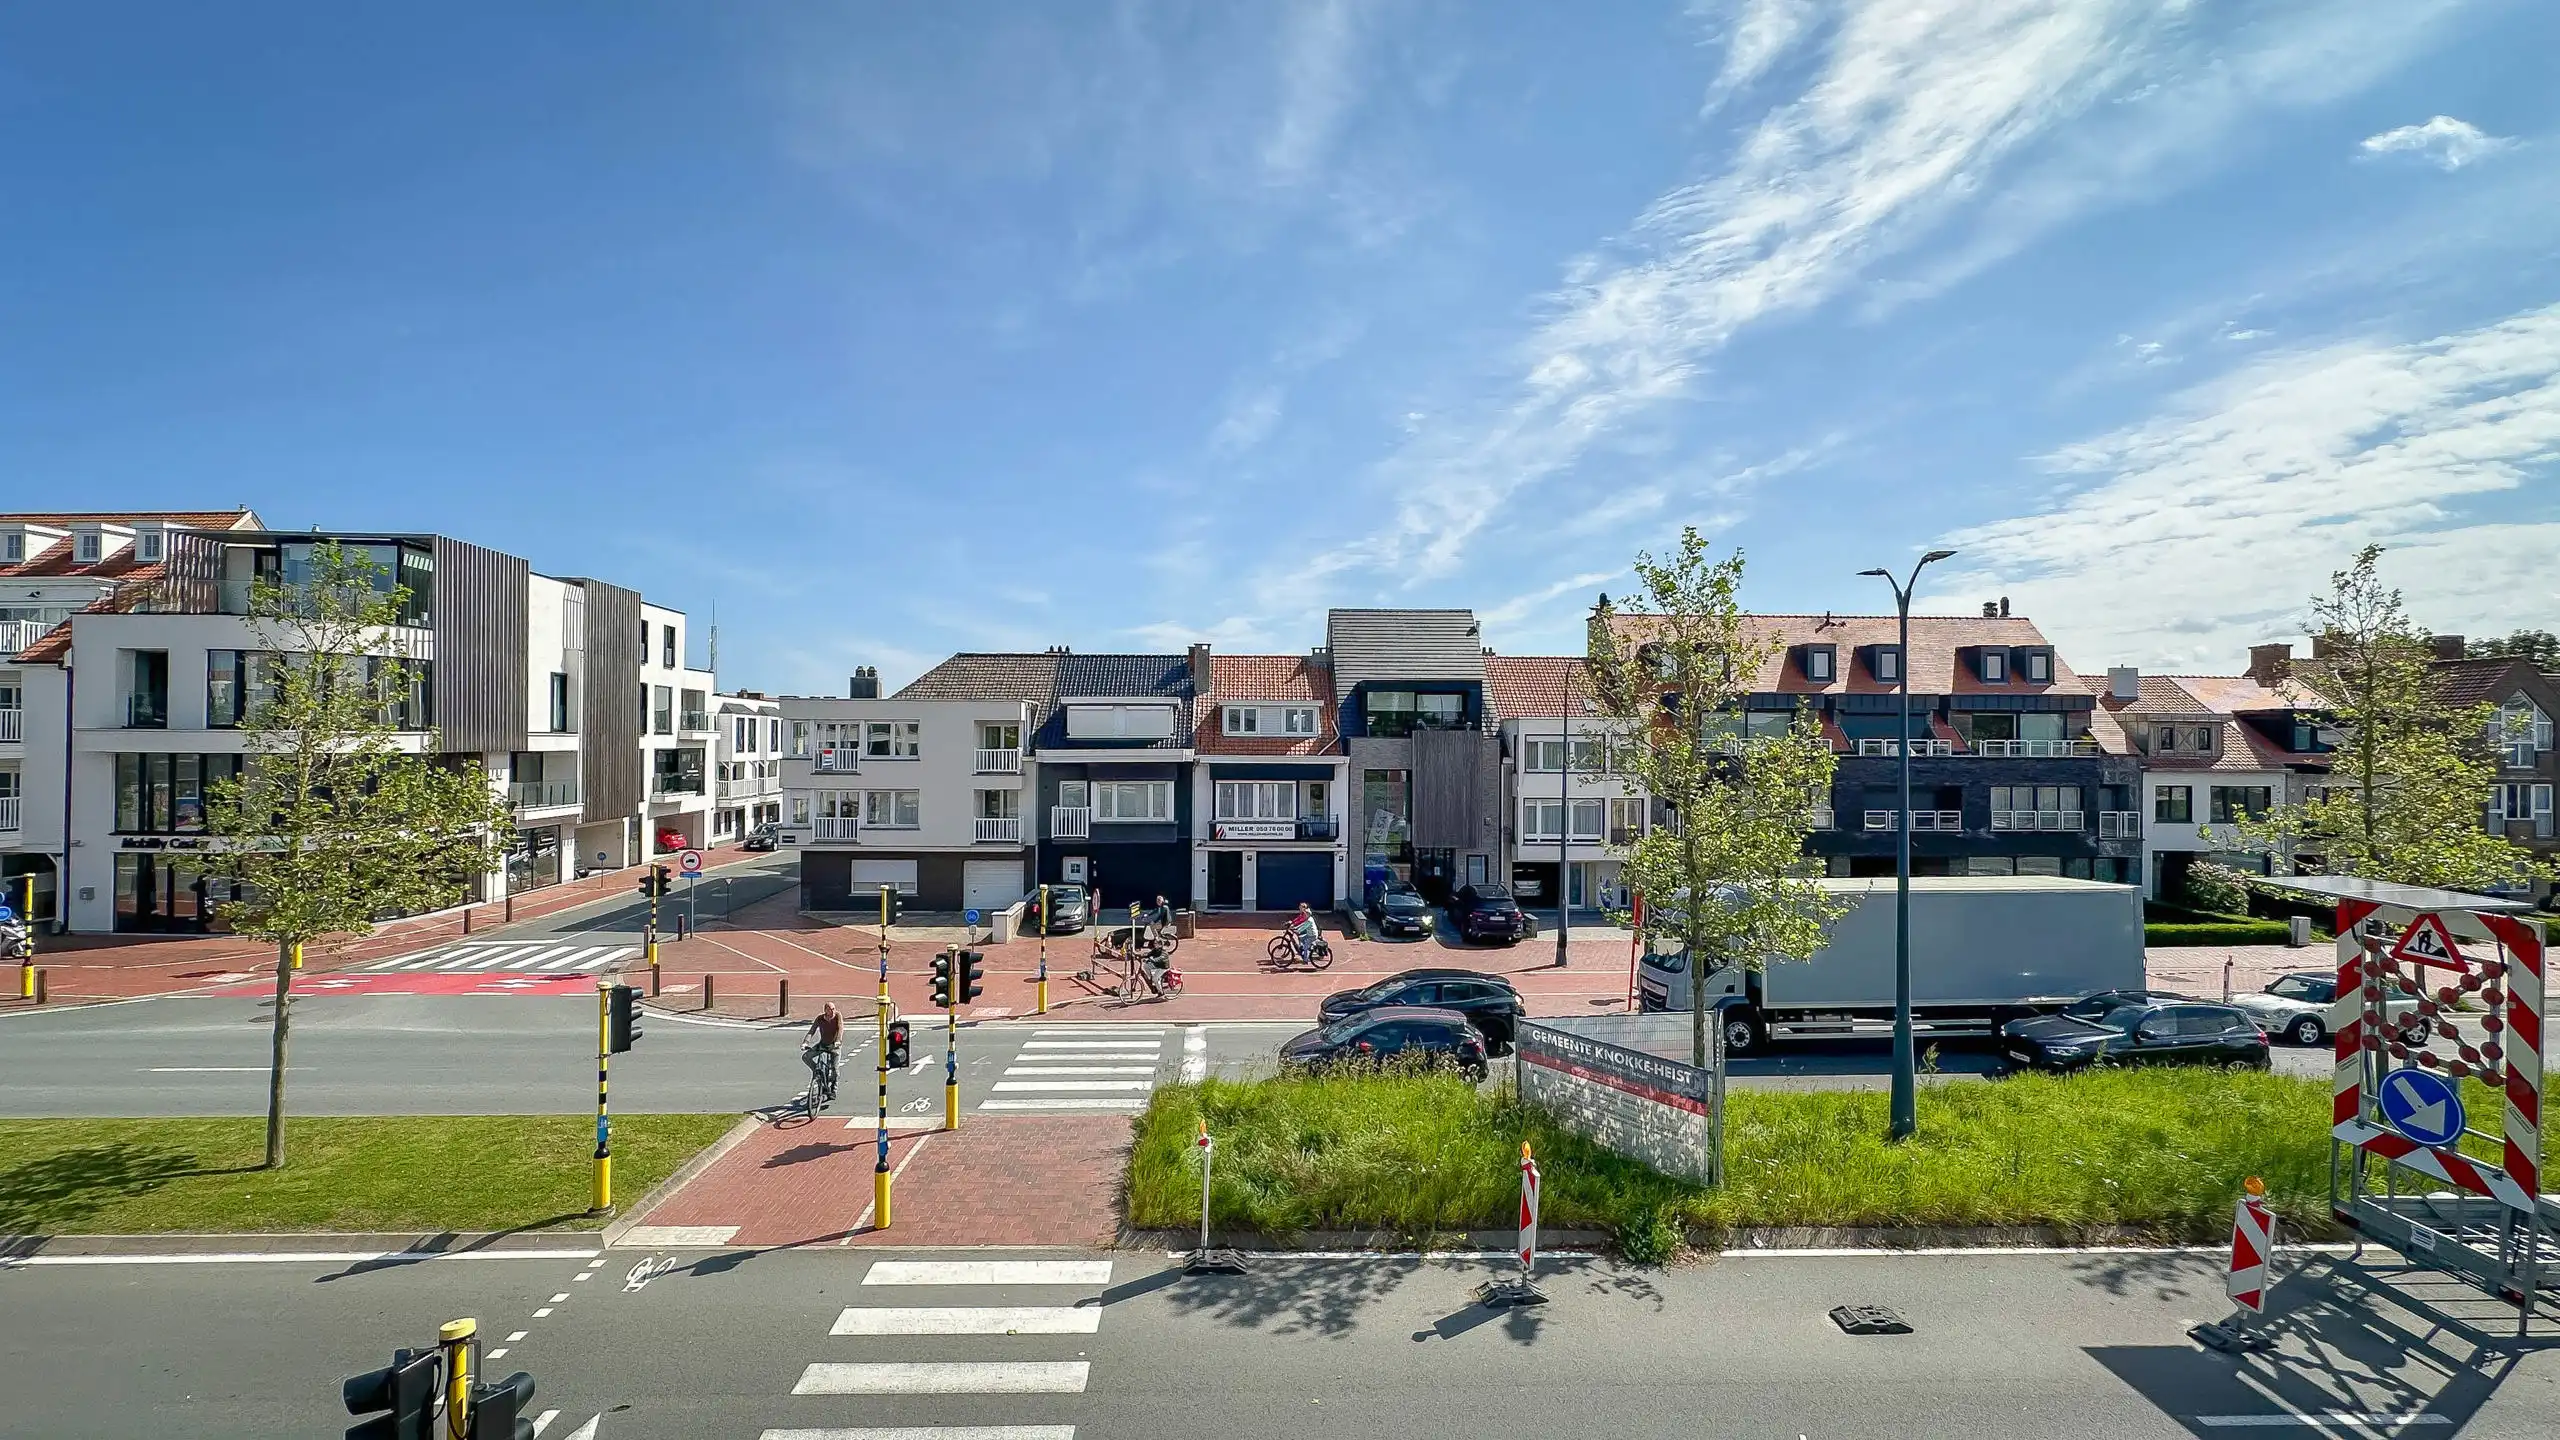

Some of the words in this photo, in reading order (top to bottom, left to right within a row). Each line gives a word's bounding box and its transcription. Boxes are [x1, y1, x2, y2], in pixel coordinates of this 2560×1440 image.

[121, 837, 168, 851] Mobility
[1532, 1029, 1592, 1057] GEMEENTE
[1594, 1046, 1693, 1085] KNOKKE-HEIST
